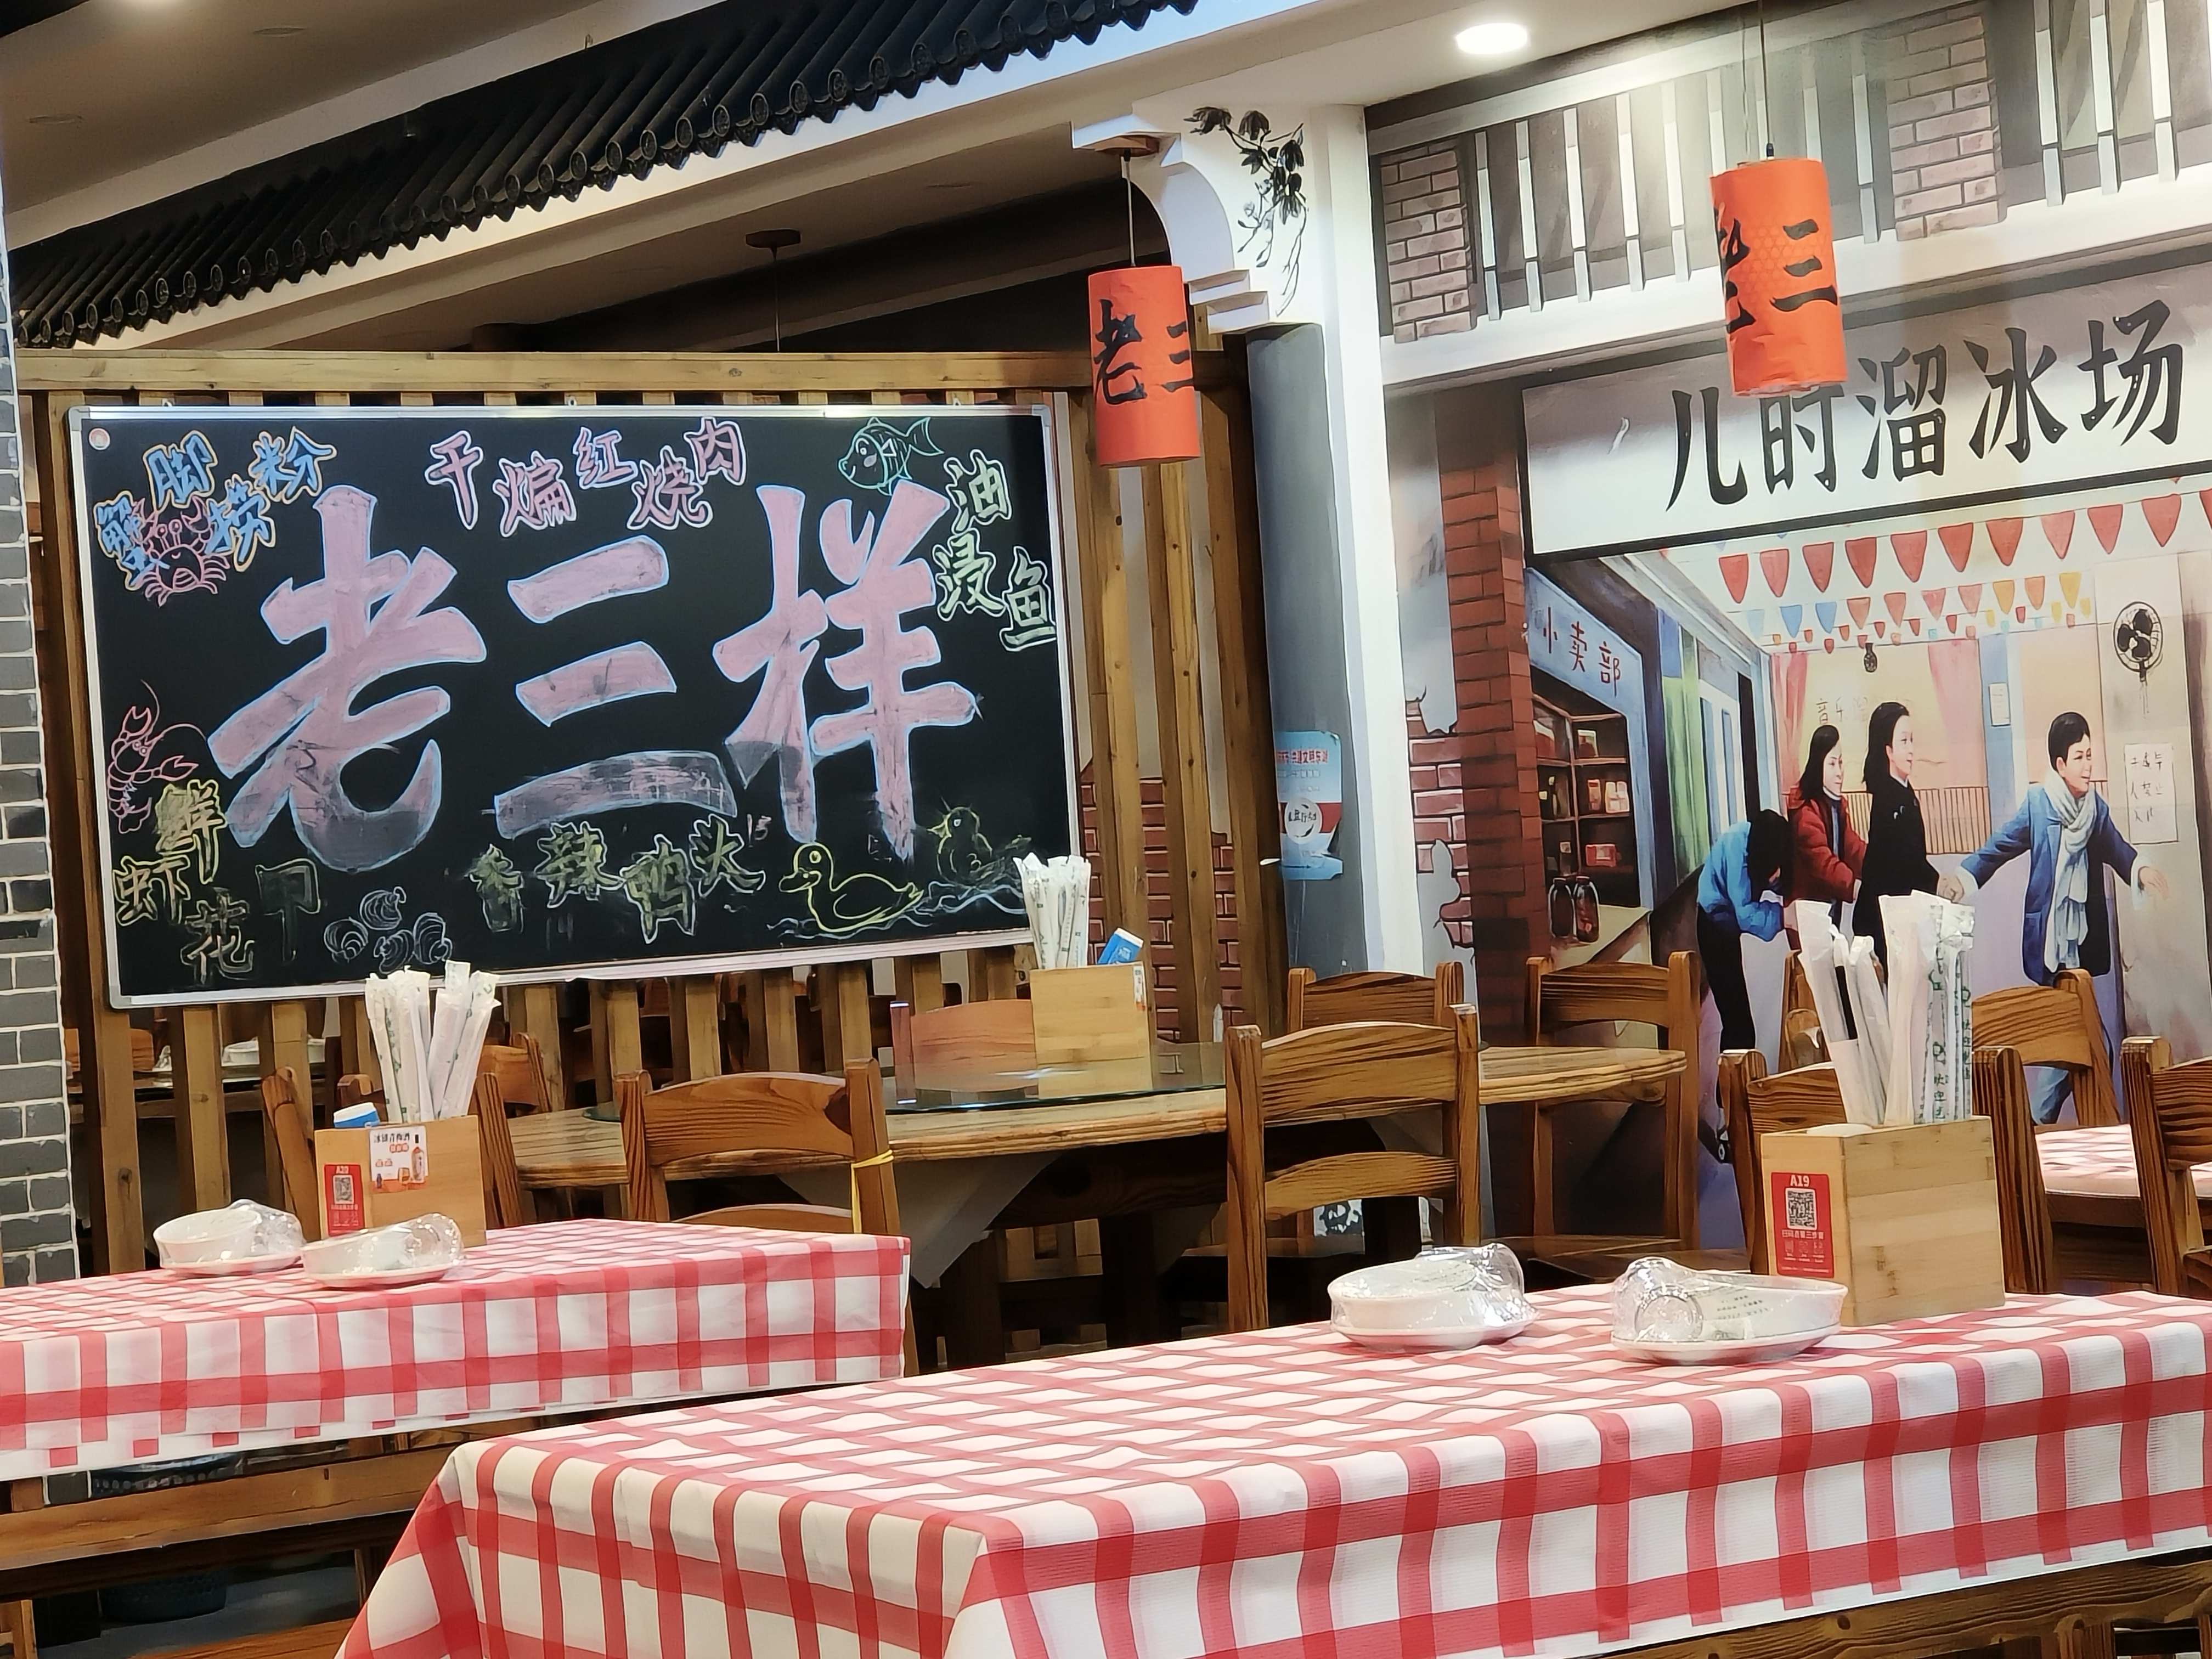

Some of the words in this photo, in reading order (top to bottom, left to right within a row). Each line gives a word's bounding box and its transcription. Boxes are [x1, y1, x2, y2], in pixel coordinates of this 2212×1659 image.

[1666, 300, 2183, 511] 儿时溜冰场
[932, 449, 1056, 651] 油浸鱼
[207, 484, 978, 872] 老三样
[1543, 606, 1620, 698] 小卖部
[1790, 1174, 1810, 1187] A19
